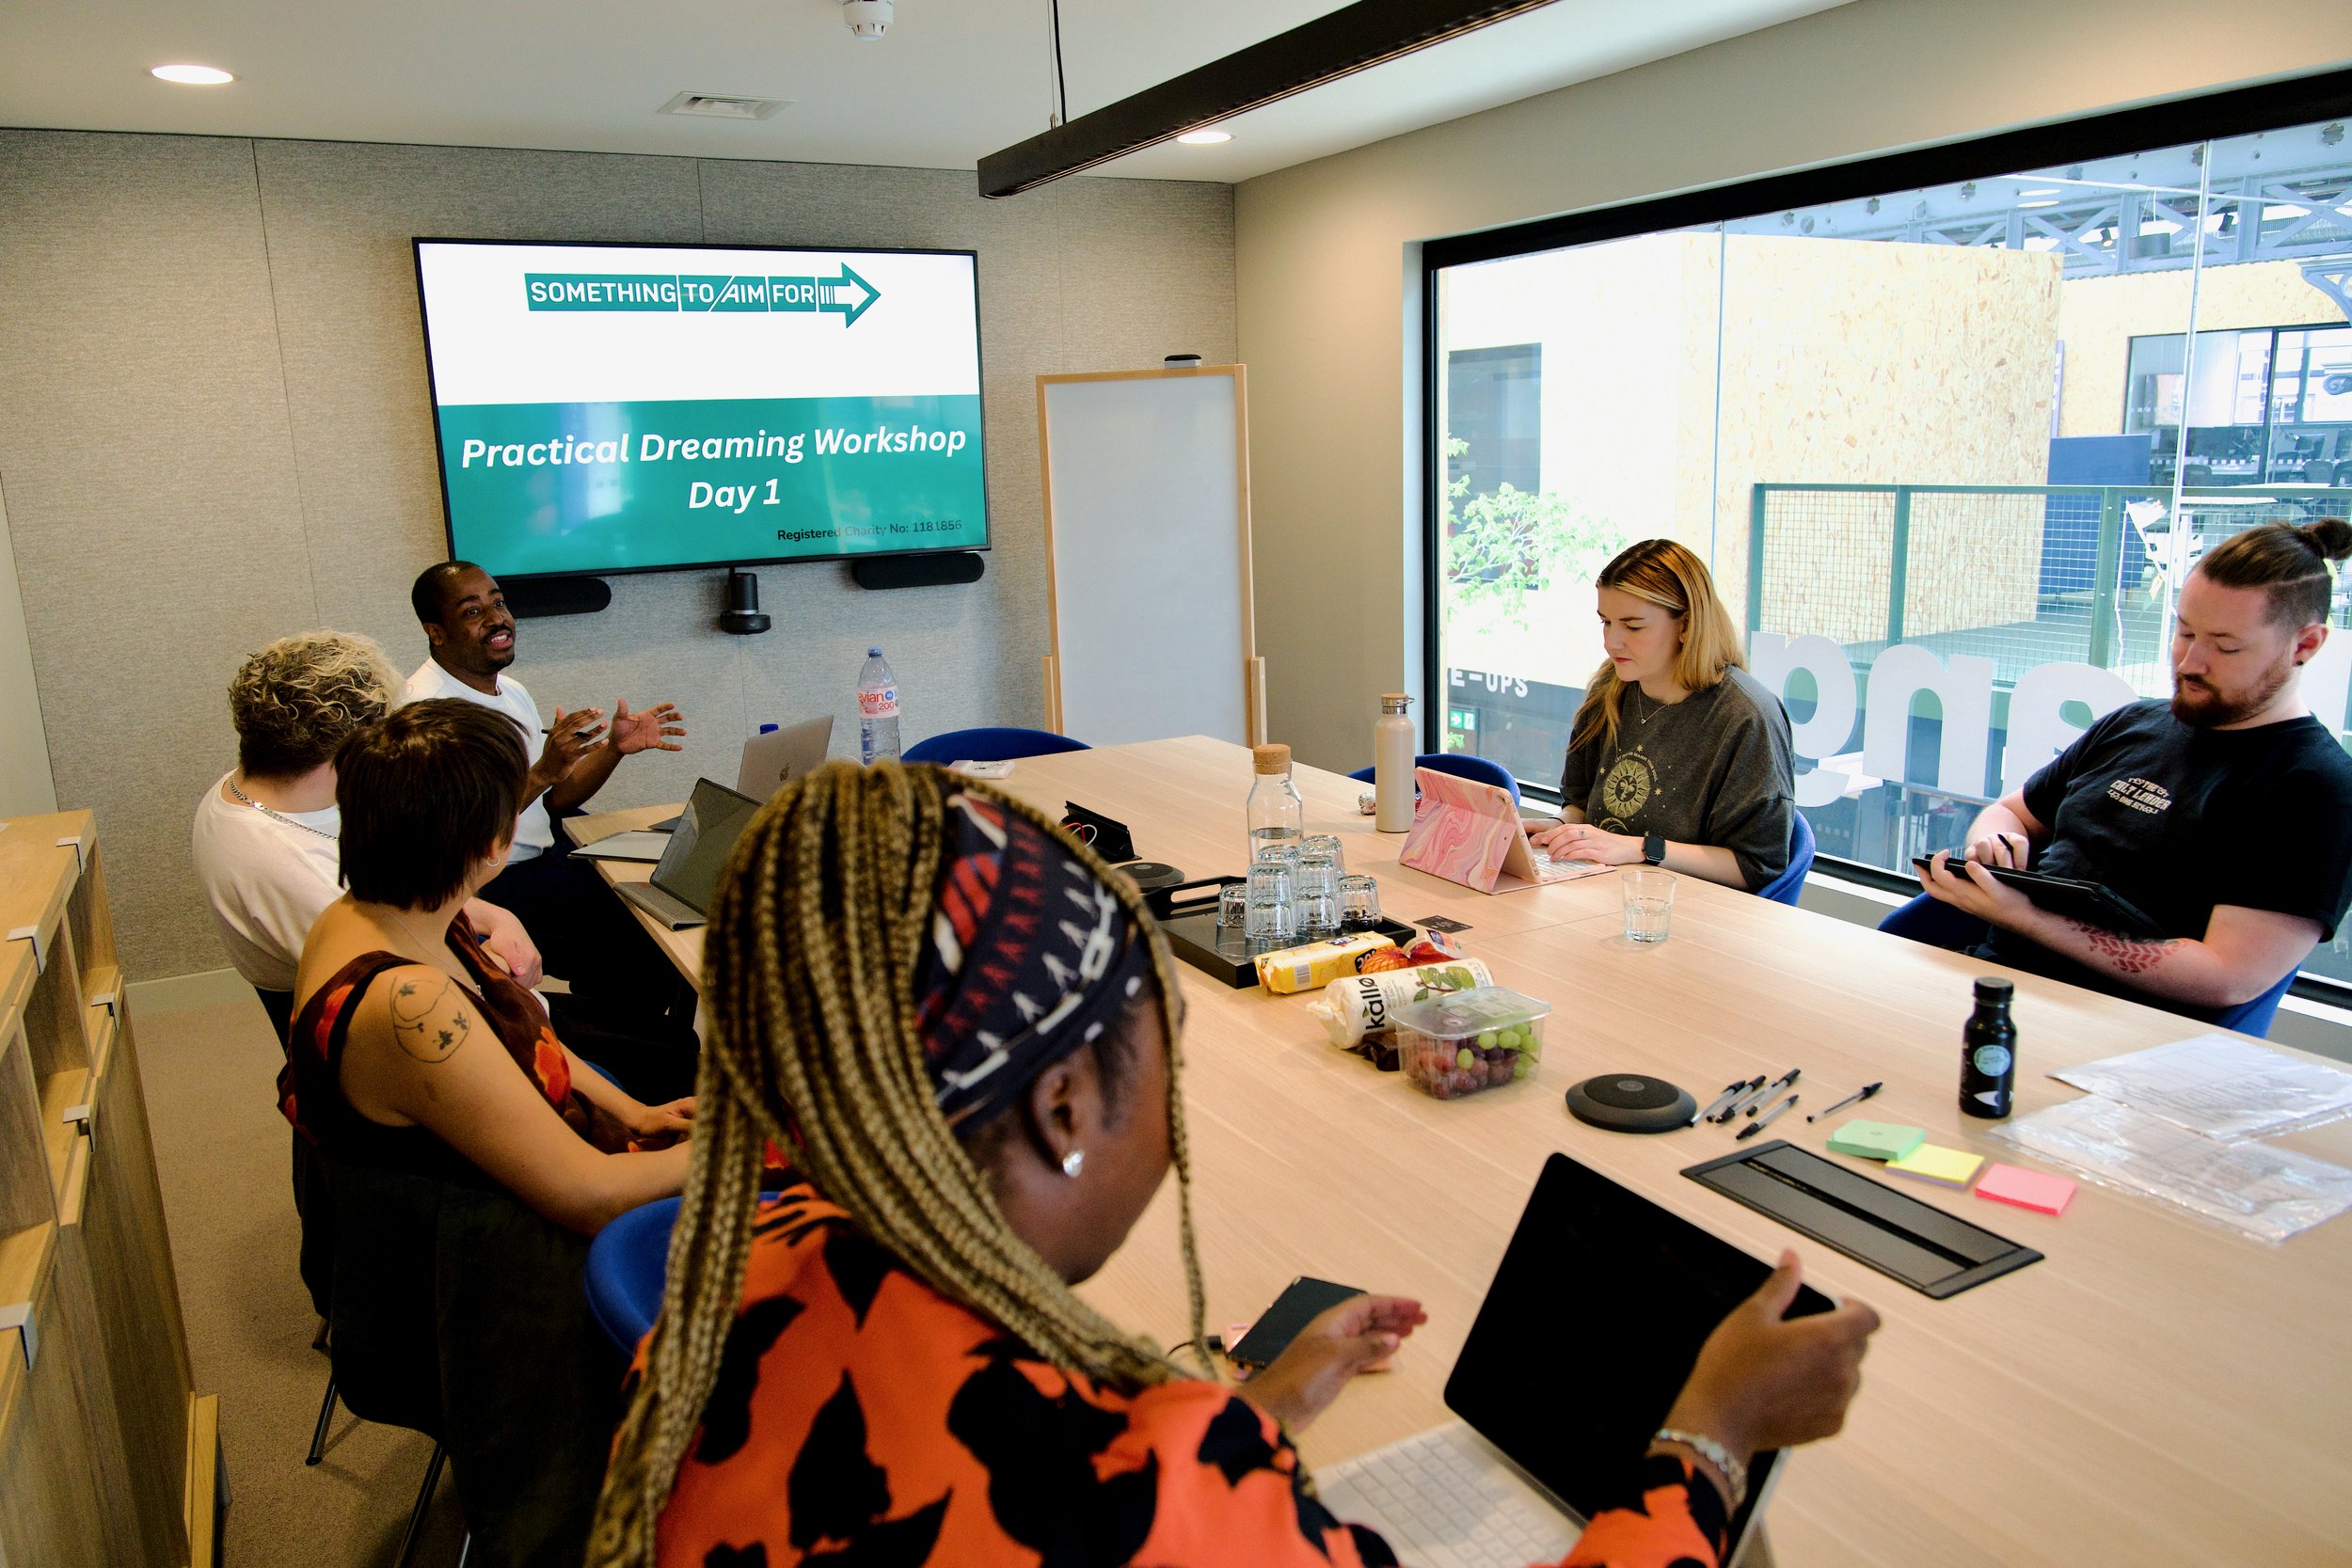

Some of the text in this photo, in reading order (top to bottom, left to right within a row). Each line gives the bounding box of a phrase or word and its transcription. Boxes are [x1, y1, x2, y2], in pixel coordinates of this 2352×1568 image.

[531, 281, 677, 304] SOMETHING
[772, 284, 815, 304] FOR
[461, 424, 966, 469] Practical Dreaming Workshop
[688, 478, 781, 515] Day 1
[777, 519, 962, 543] Registered Charity No: 1181856
[879, 701, 895, 711] 200
